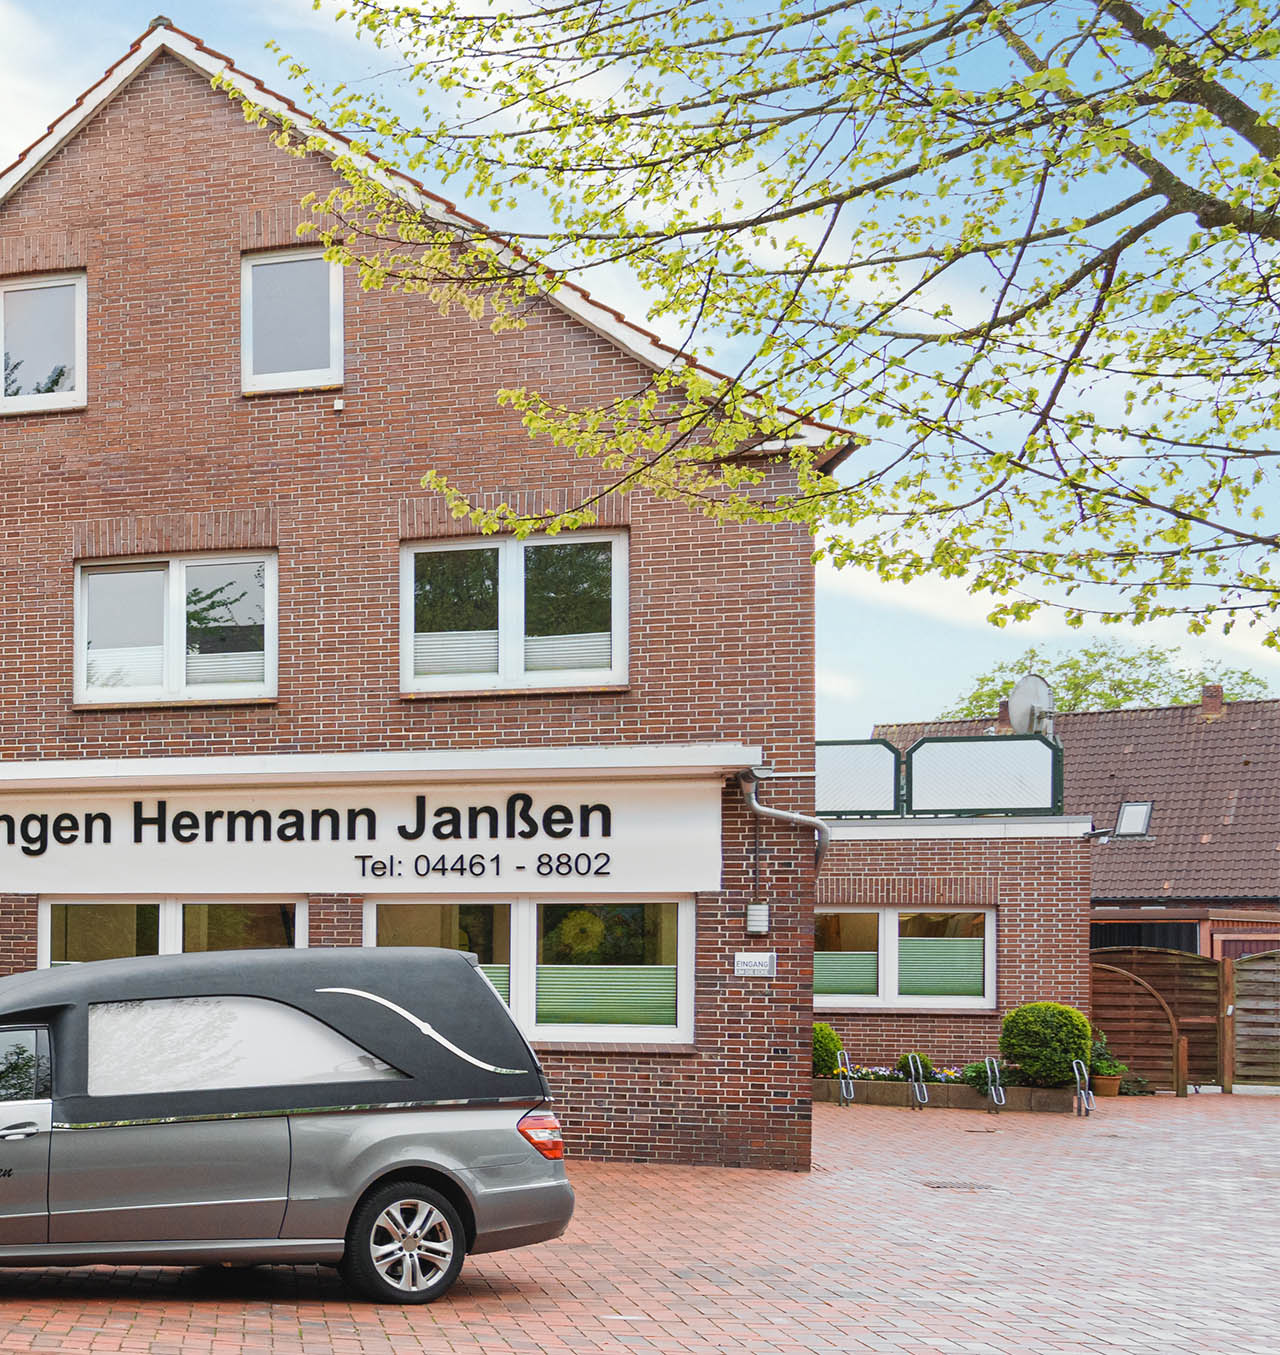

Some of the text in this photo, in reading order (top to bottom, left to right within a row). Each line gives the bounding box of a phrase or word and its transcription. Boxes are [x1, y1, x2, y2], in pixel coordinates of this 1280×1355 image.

[133, 800, 377, 844] Hermann
[397, 793, 612, 841] Janßen
[355, 855, 403, 877] Tel:
[414, 853, 502, 877] 04461
[536, 852, 612, 876] 8802
[736, 960, 769, 968] EINGANG
